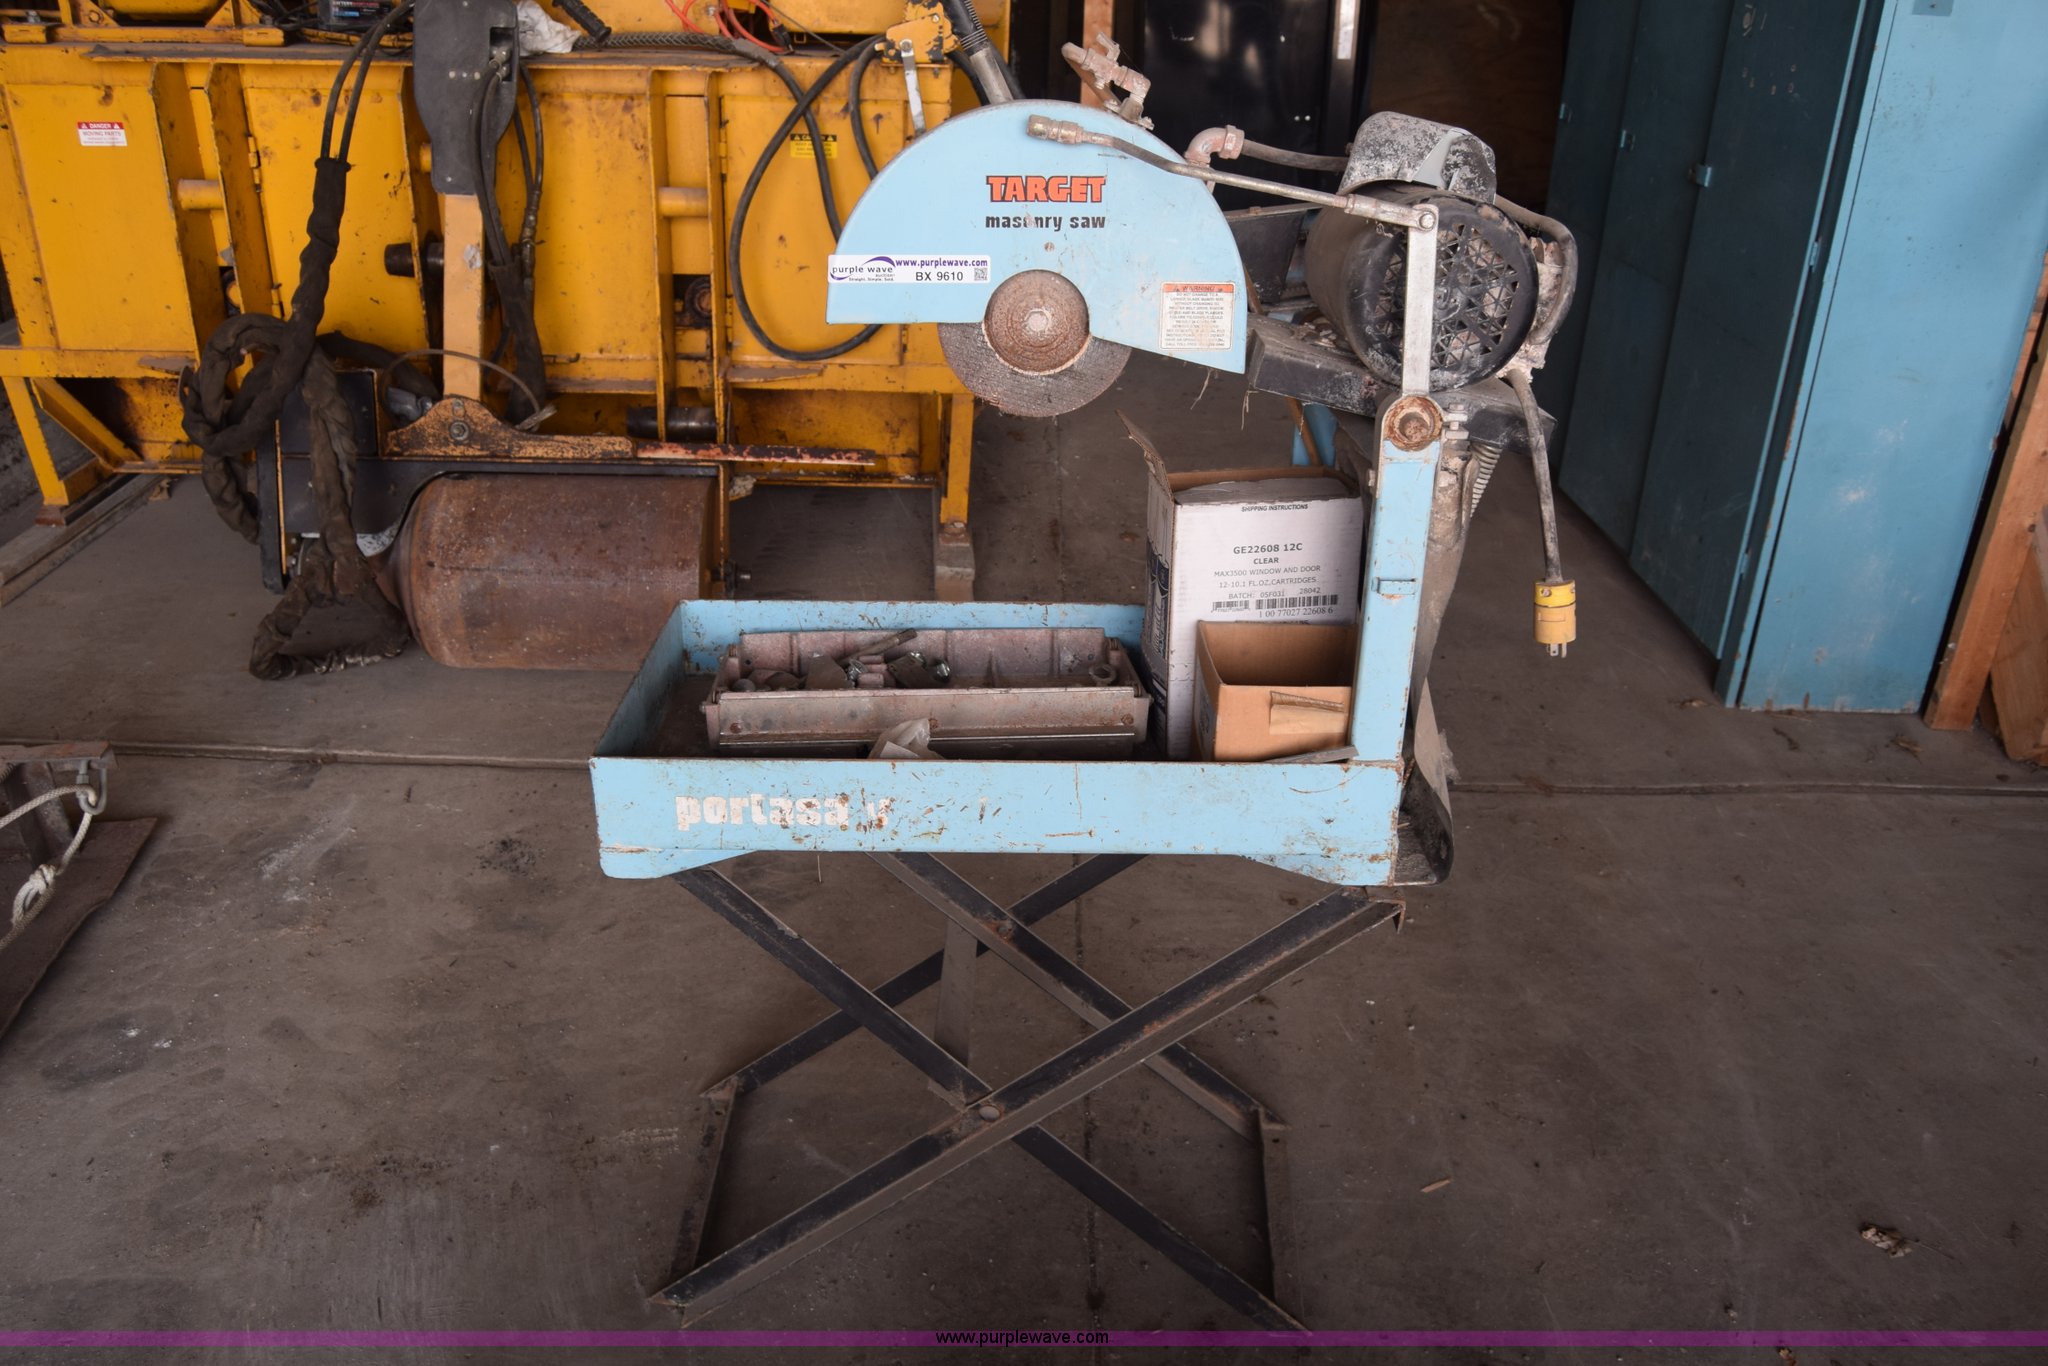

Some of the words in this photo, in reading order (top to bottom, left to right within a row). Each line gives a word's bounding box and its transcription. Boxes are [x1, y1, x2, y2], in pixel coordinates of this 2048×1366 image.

[986, 175, 1106, 203] TARGET
[1070, 216, 1106, 229] saw
[895, 257, 988, 268] www.purplewave.com
[832, 265, 864, 274] purple
[915, 272, 932, 281] BX
[937, 271, 963, 281] 9610
[1241, 504, 1268, 512] SHIPPING
[1268, 503, 1308, 511] INSTRUCTIONS
[1233, 544, 1280, 555] GE22608
[1283, 543, 1303, 552] 12C
[1253, 557, 1279, 565] CLEAR
[1249, 567, 1281, 575] WINDOW
[1219, 580, 1246, 588] 12-10.1
[1228, 592, 1255, 600] BATCH:
[1299, 587, 1321, 595] 28042
[1277, 608, 1300, 617] 77027
[1302, 607, 1326, 616] 22608
[1328, 606, 1334, 614] 6
